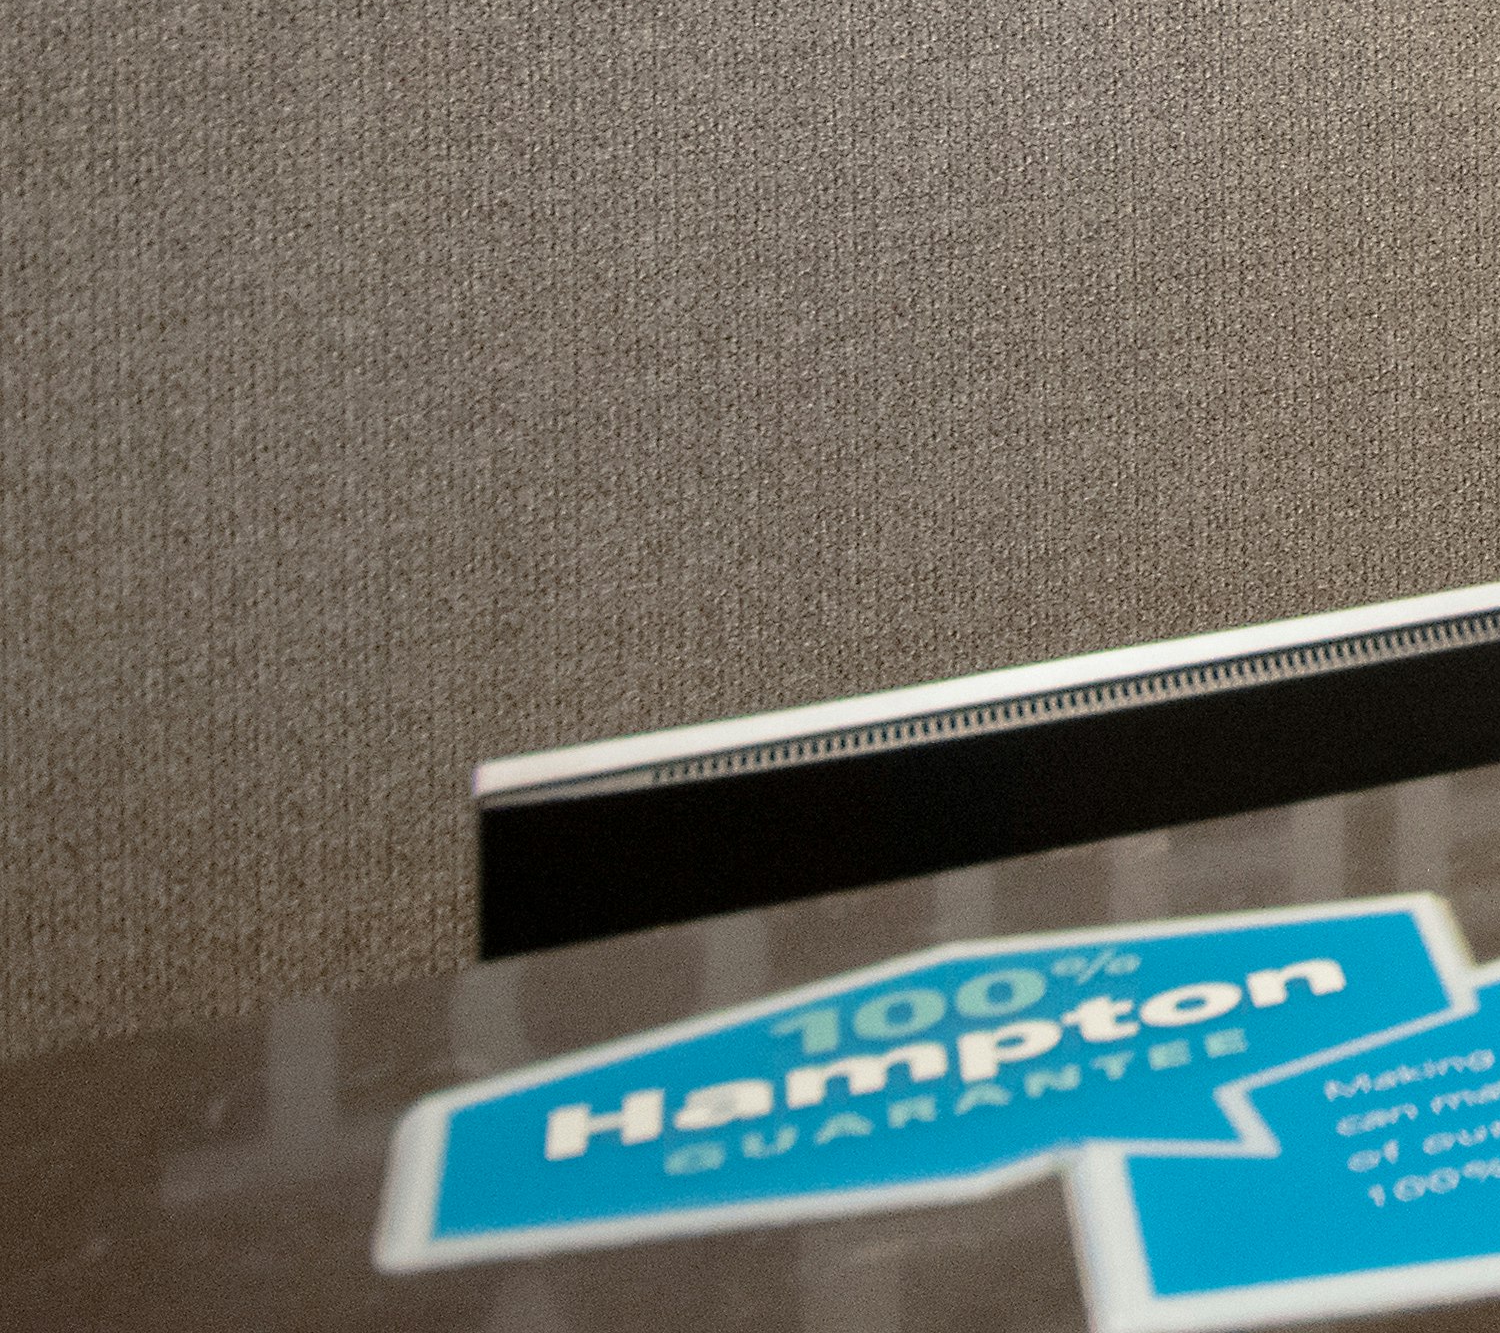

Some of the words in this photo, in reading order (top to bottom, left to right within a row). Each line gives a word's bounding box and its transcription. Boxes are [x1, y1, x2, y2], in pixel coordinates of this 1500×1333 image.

[771, 947, 1142, 1055] 100%
[543, 958, 1347, 1162] Hampton
[1324, 1048, 1496, 1101] Making
[663, 1028, 1249, 1178] GUARANTEE
[1336, 1102, 1419, 1137] can
[1346, 1138, 1399, 1173] of
